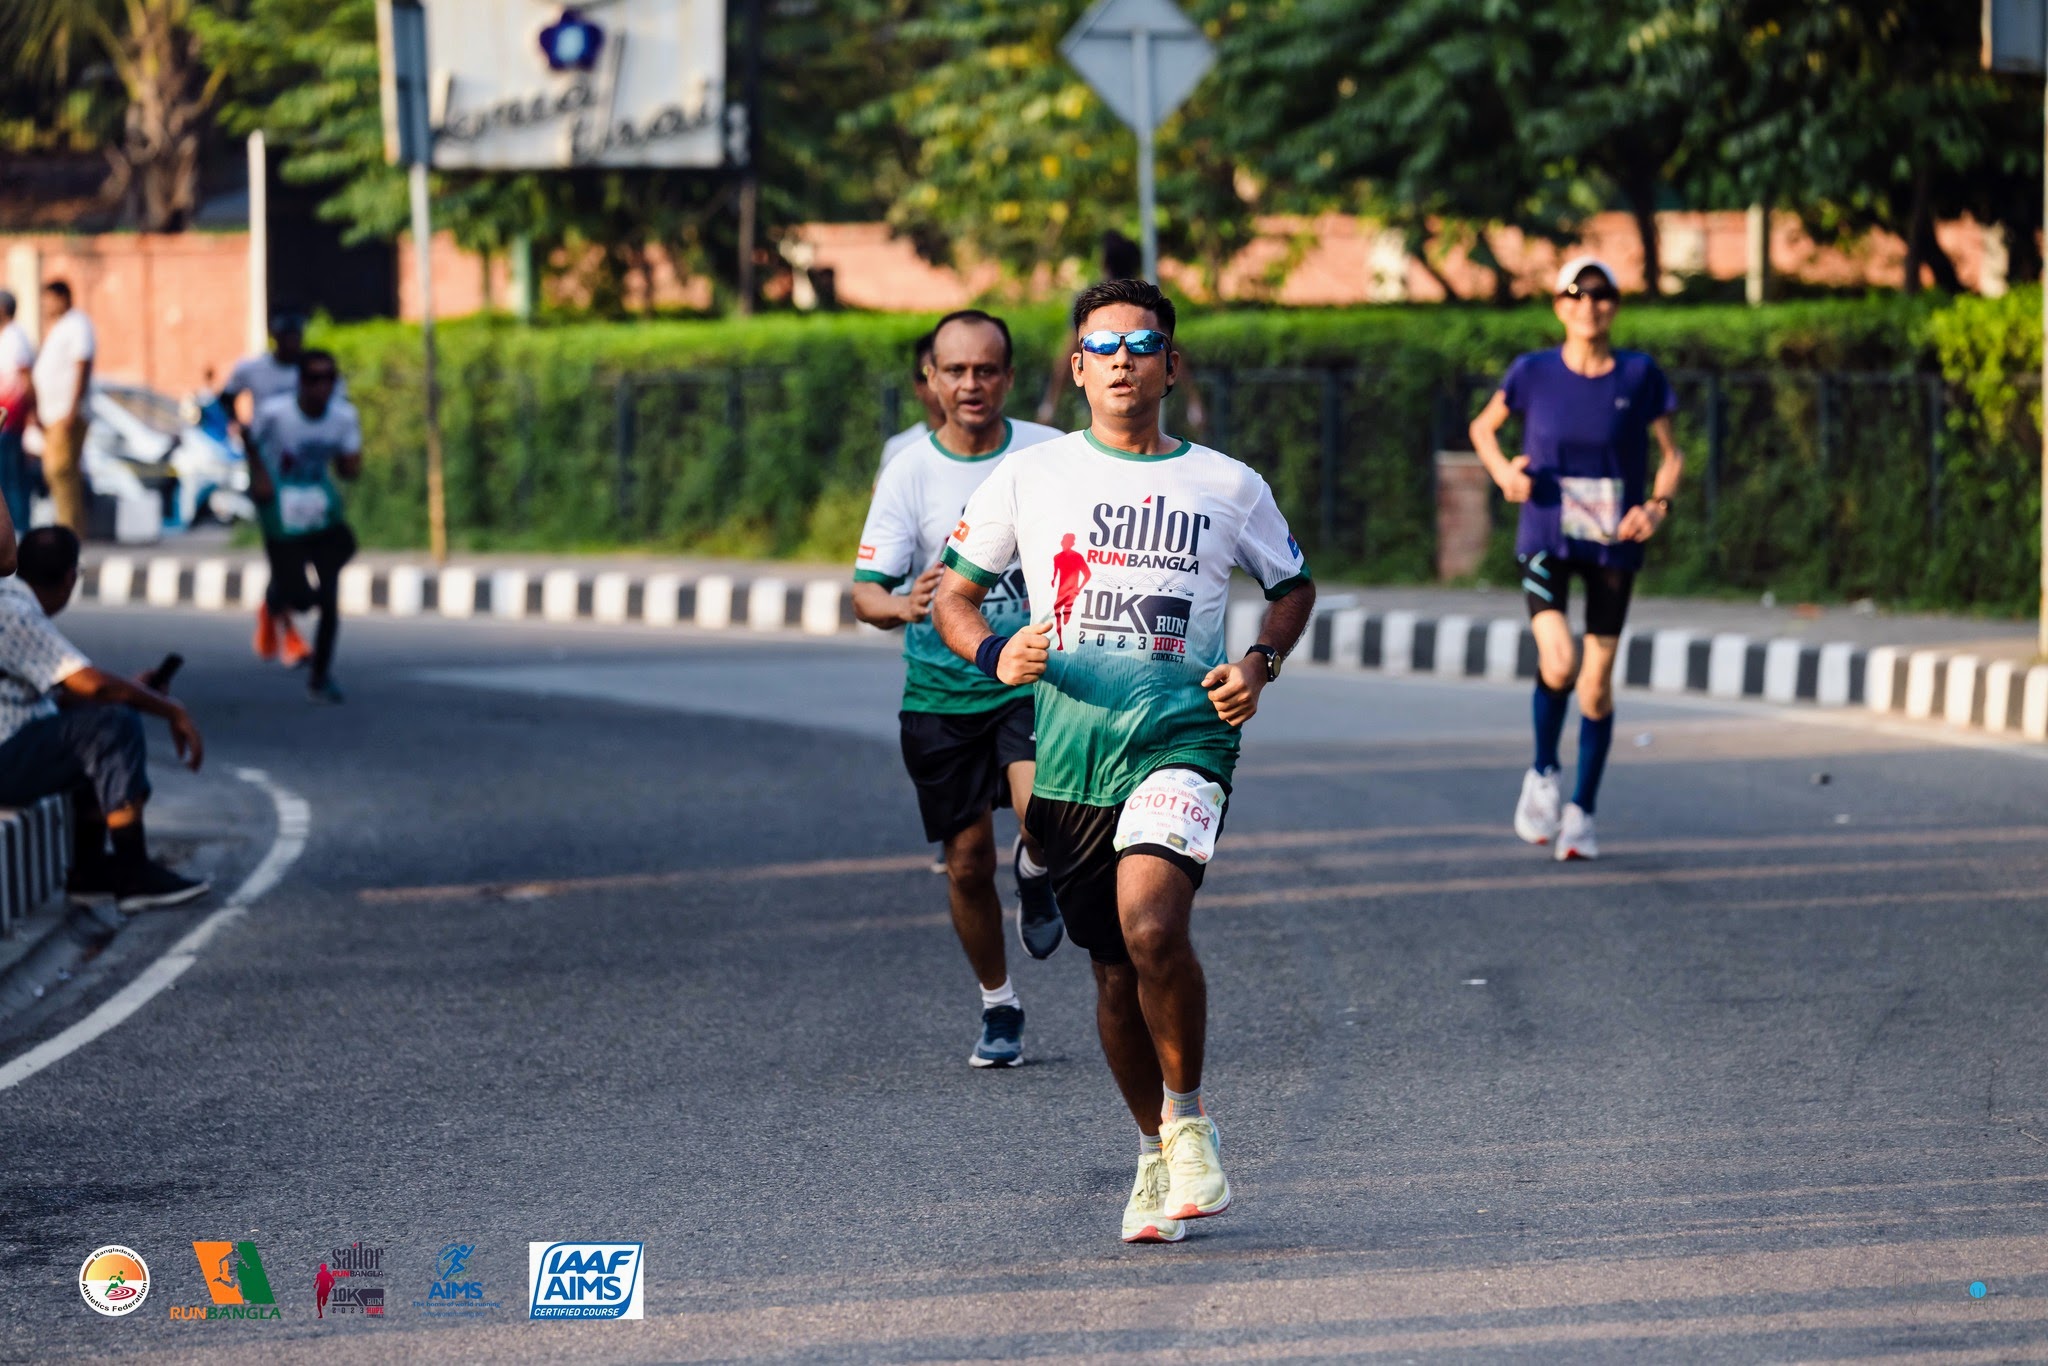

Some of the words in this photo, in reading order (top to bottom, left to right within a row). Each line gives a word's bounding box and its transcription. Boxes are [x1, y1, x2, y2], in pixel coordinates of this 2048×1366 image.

[1089, 495, 1211, 556] sailor
[1087, 549, 1199, 575] RUNBANGLA
[1080, 589, 1147, 634] 10K
[1154, 615, 1187, 635] RUN
[1151, 652, 1185, 664] CONNECT
[1152, 636, 1186, 654] HOPE
[1129, 793, 1211, 831] C101164
